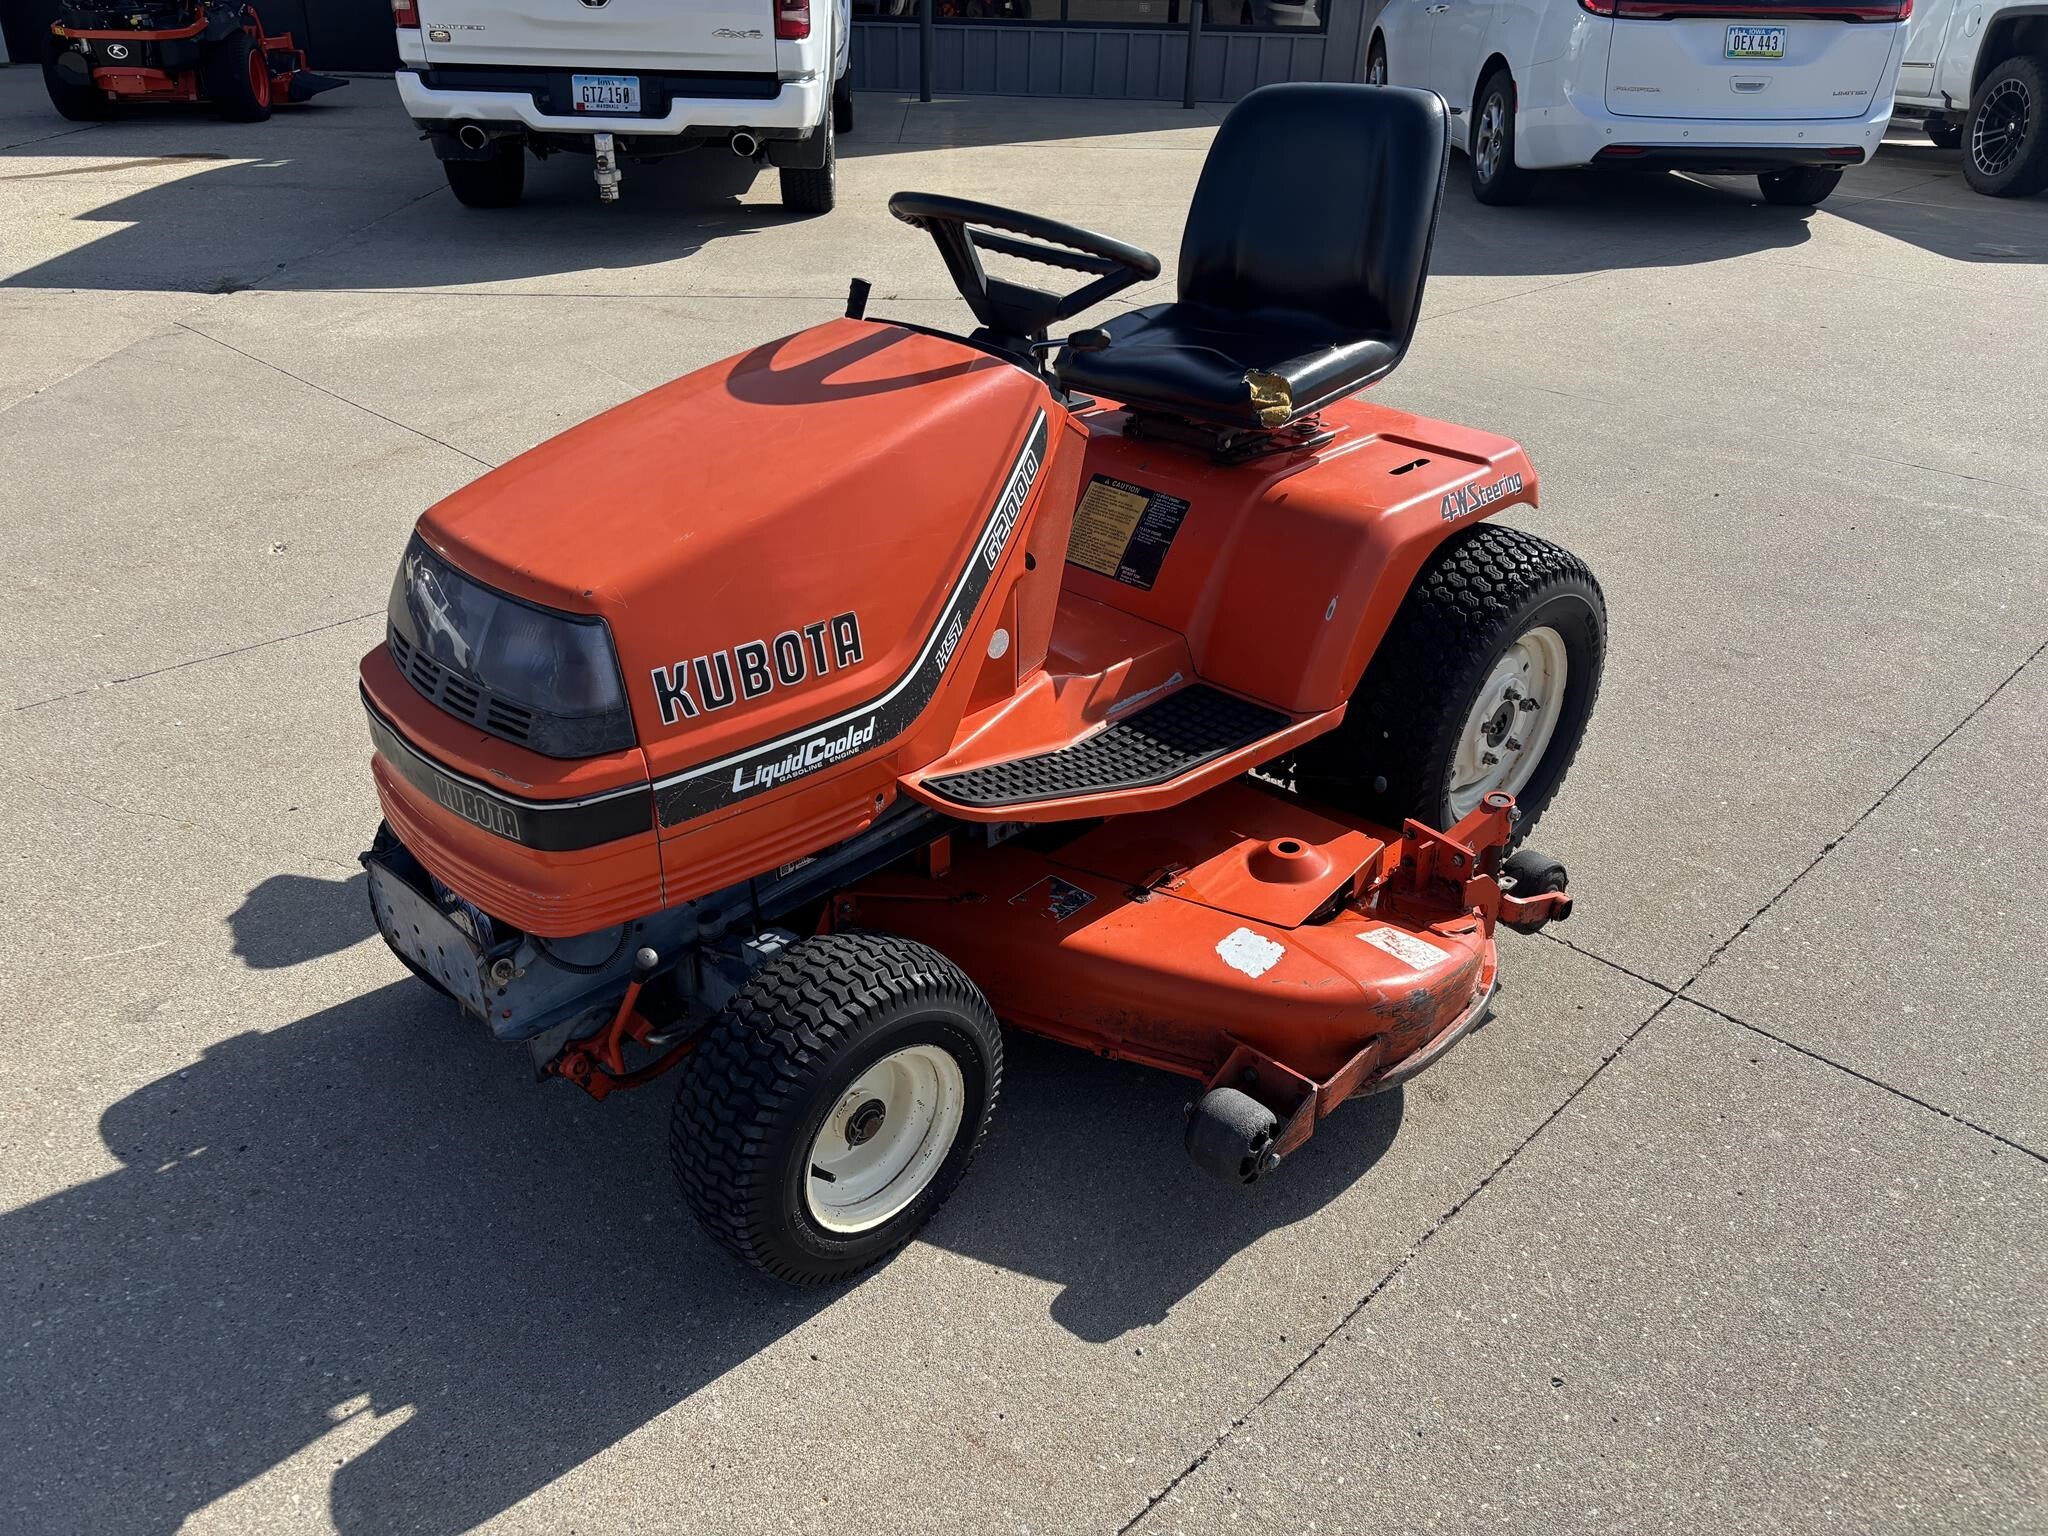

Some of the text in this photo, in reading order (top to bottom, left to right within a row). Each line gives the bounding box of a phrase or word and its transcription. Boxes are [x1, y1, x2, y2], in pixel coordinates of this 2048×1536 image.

[1758, 36, 1778, 50] 443
[582, 86, 629, 104] GTZ 150
[984, 449, 1038, 571] G2000
[1112, 480, 1140, 494] CAUTION
[934, 610, 964, 674] HST
[651, 610, 864, 725] KUBOTA
[779, 746, 860, 782] GASOLINE ENGINE
[434, 774, 521, 840] KUBOTA
